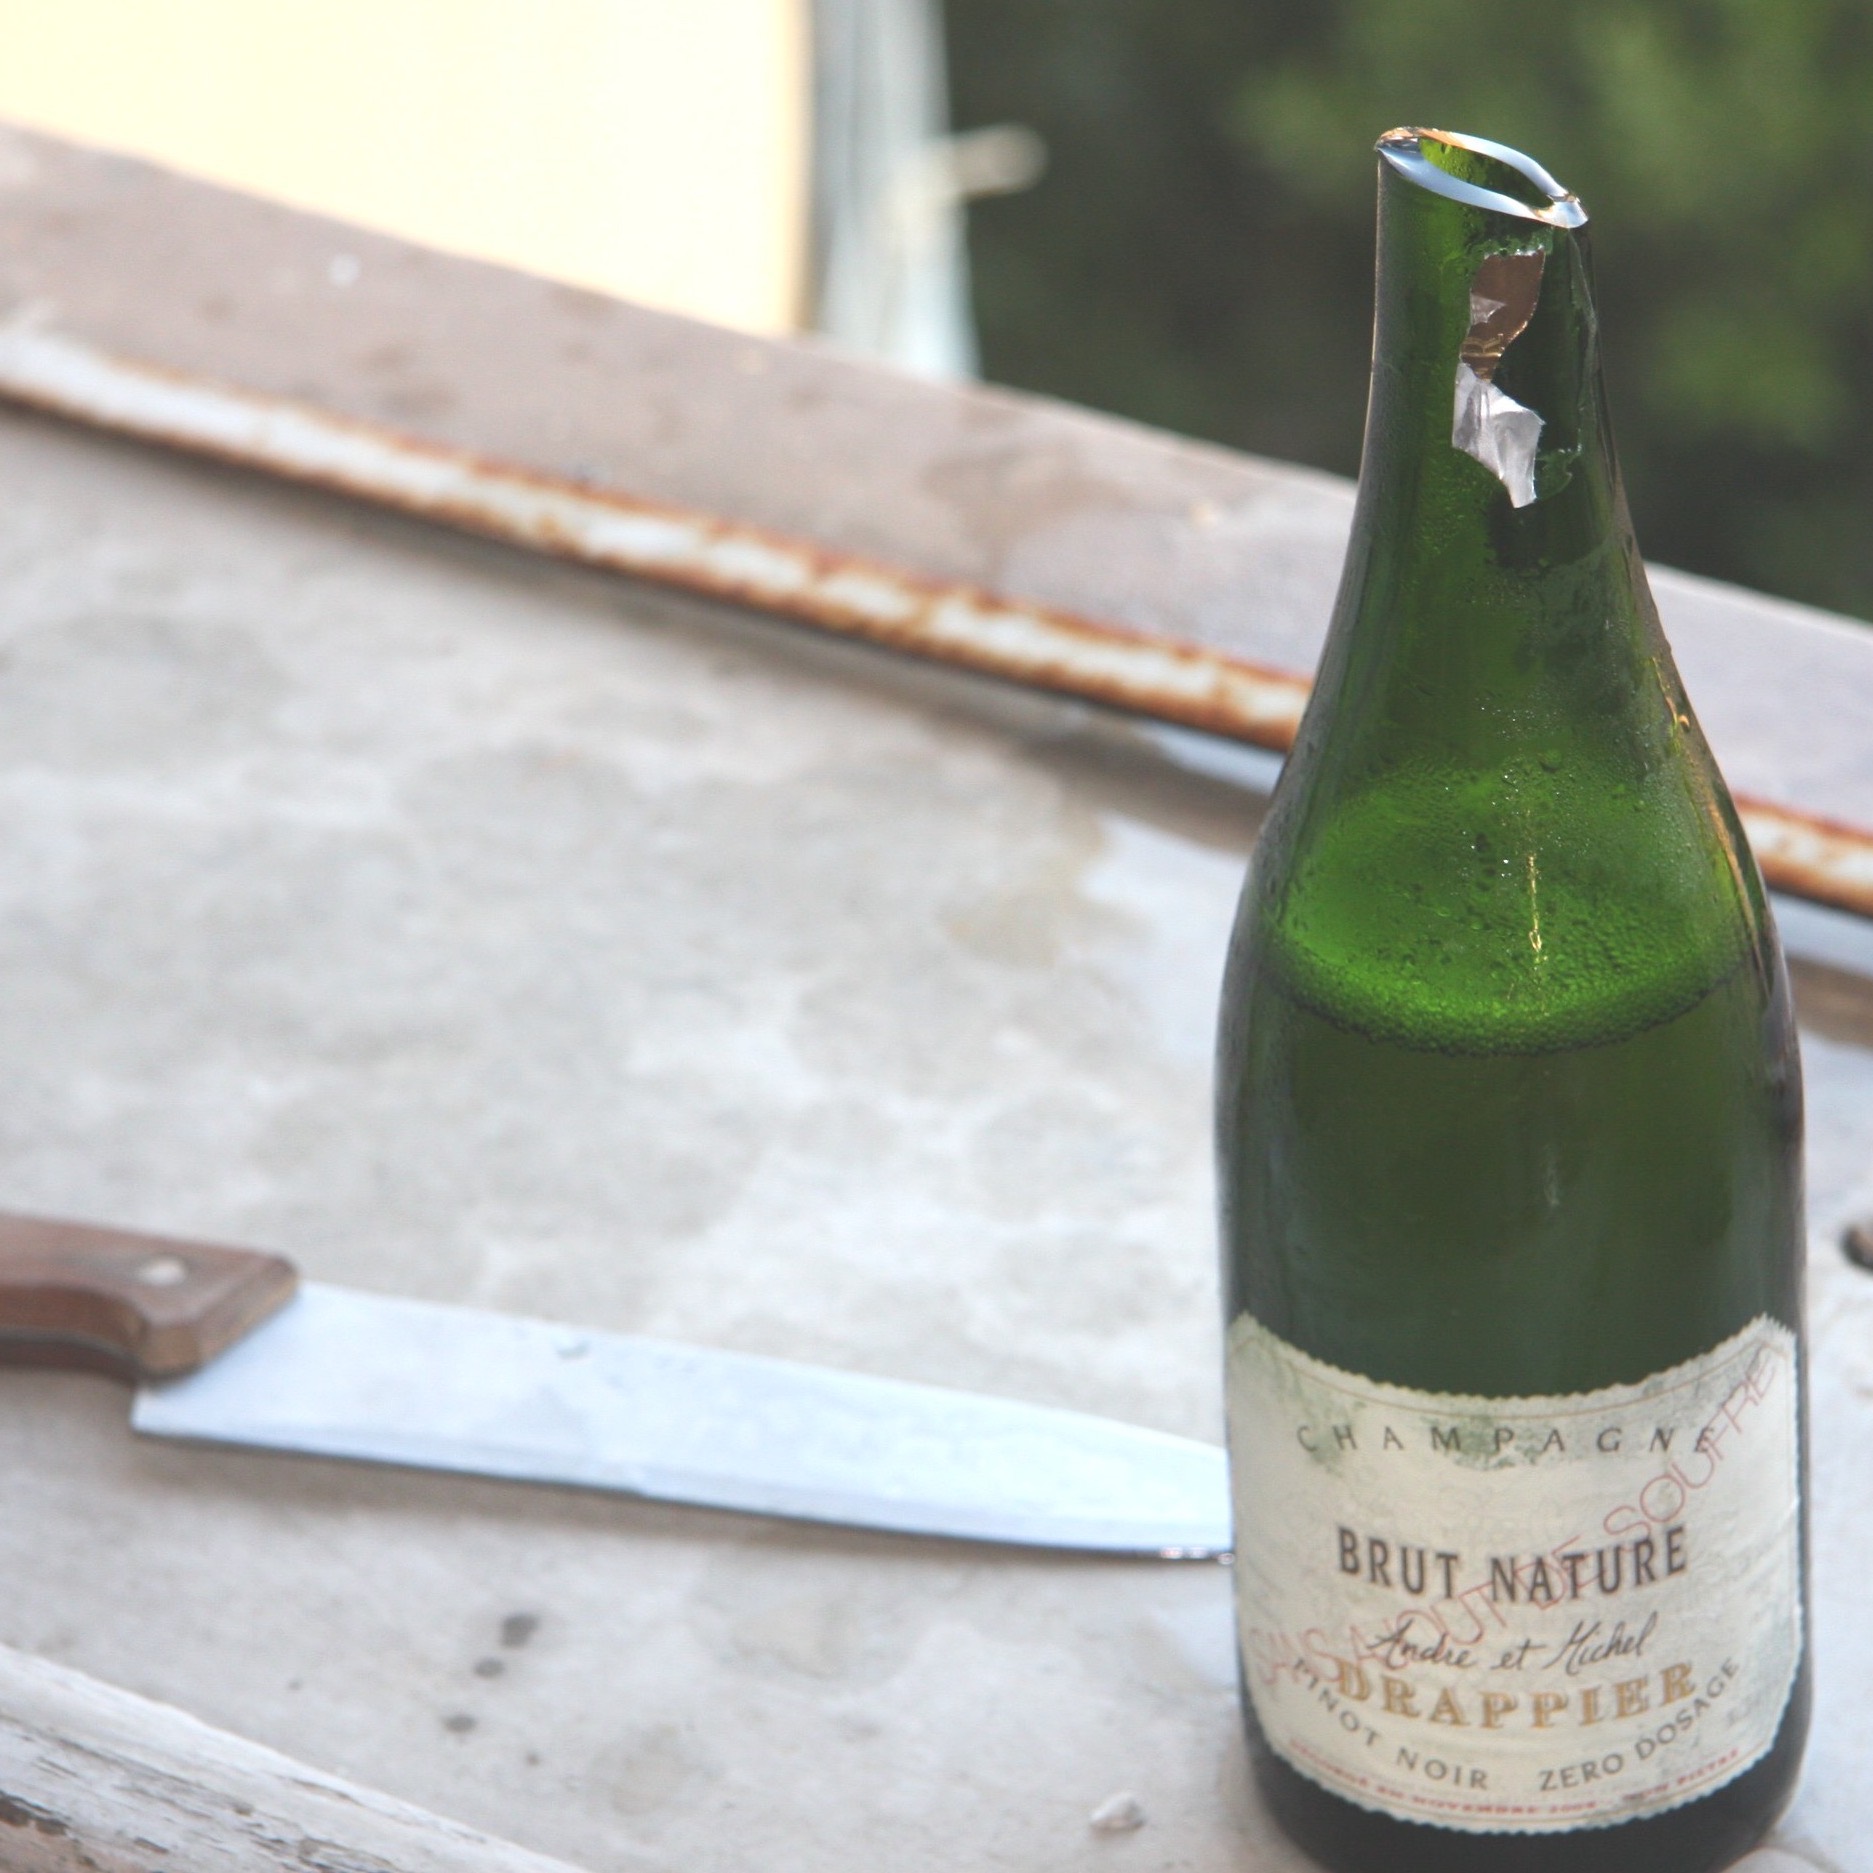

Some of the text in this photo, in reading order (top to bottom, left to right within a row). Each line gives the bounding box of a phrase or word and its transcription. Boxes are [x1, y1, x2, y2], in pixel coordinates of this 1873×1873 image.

[1297, 1424, 1715, 1453] CHAMPAGNE
[1338, 1523, 1687, 1603] BRUT NATURE
[1490, 1638, 1547, 1671] et
[1543, 1611, 1658, 1676] Michel
[1293, 1657, 1381, 1748] PINOT
[1396, 1747, 1489, 1790] NOIR
[1538, 1753, 1625, 1792] ZERO
[1634, 1656, 1740, 1761] DOSAGE
[1334, 1658, 1697, 1729] DRAPPIER
